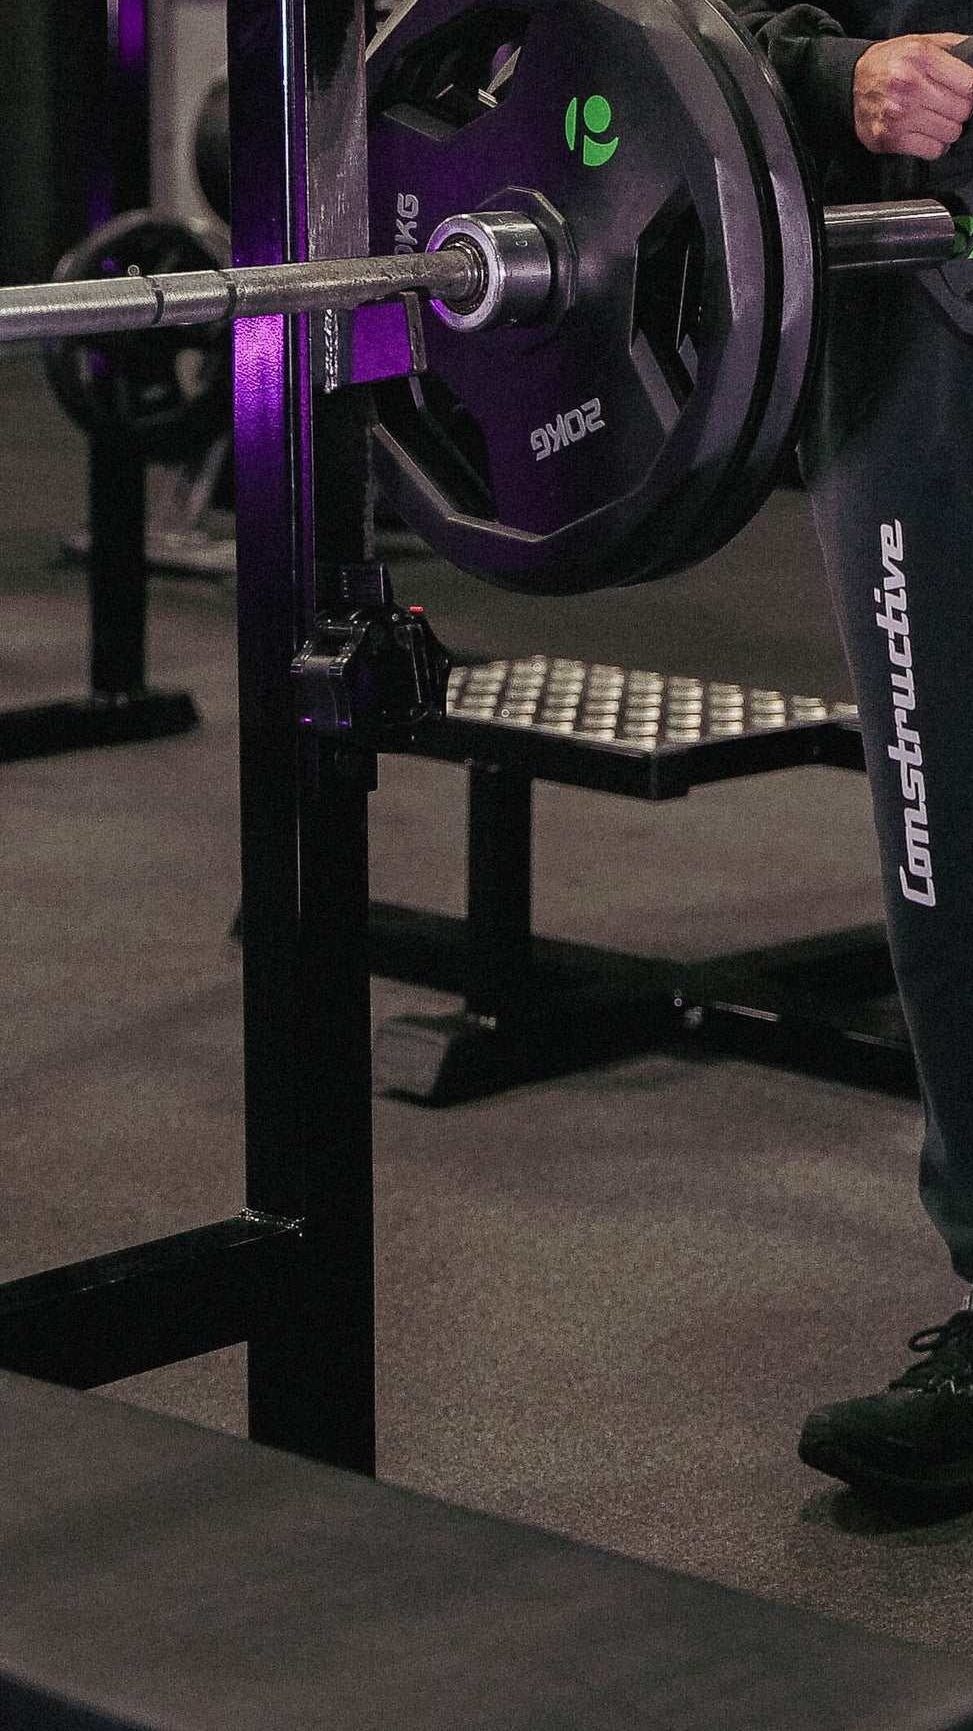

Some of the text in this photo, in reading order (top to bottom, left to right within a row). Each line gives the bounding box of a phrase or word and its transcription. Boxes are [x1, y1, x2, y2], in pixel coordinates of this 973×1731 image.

[395, 192, 419, 254] KG
[530, 397, 606, 461] 20KG
[875, 518, 937, 908] Constructive
